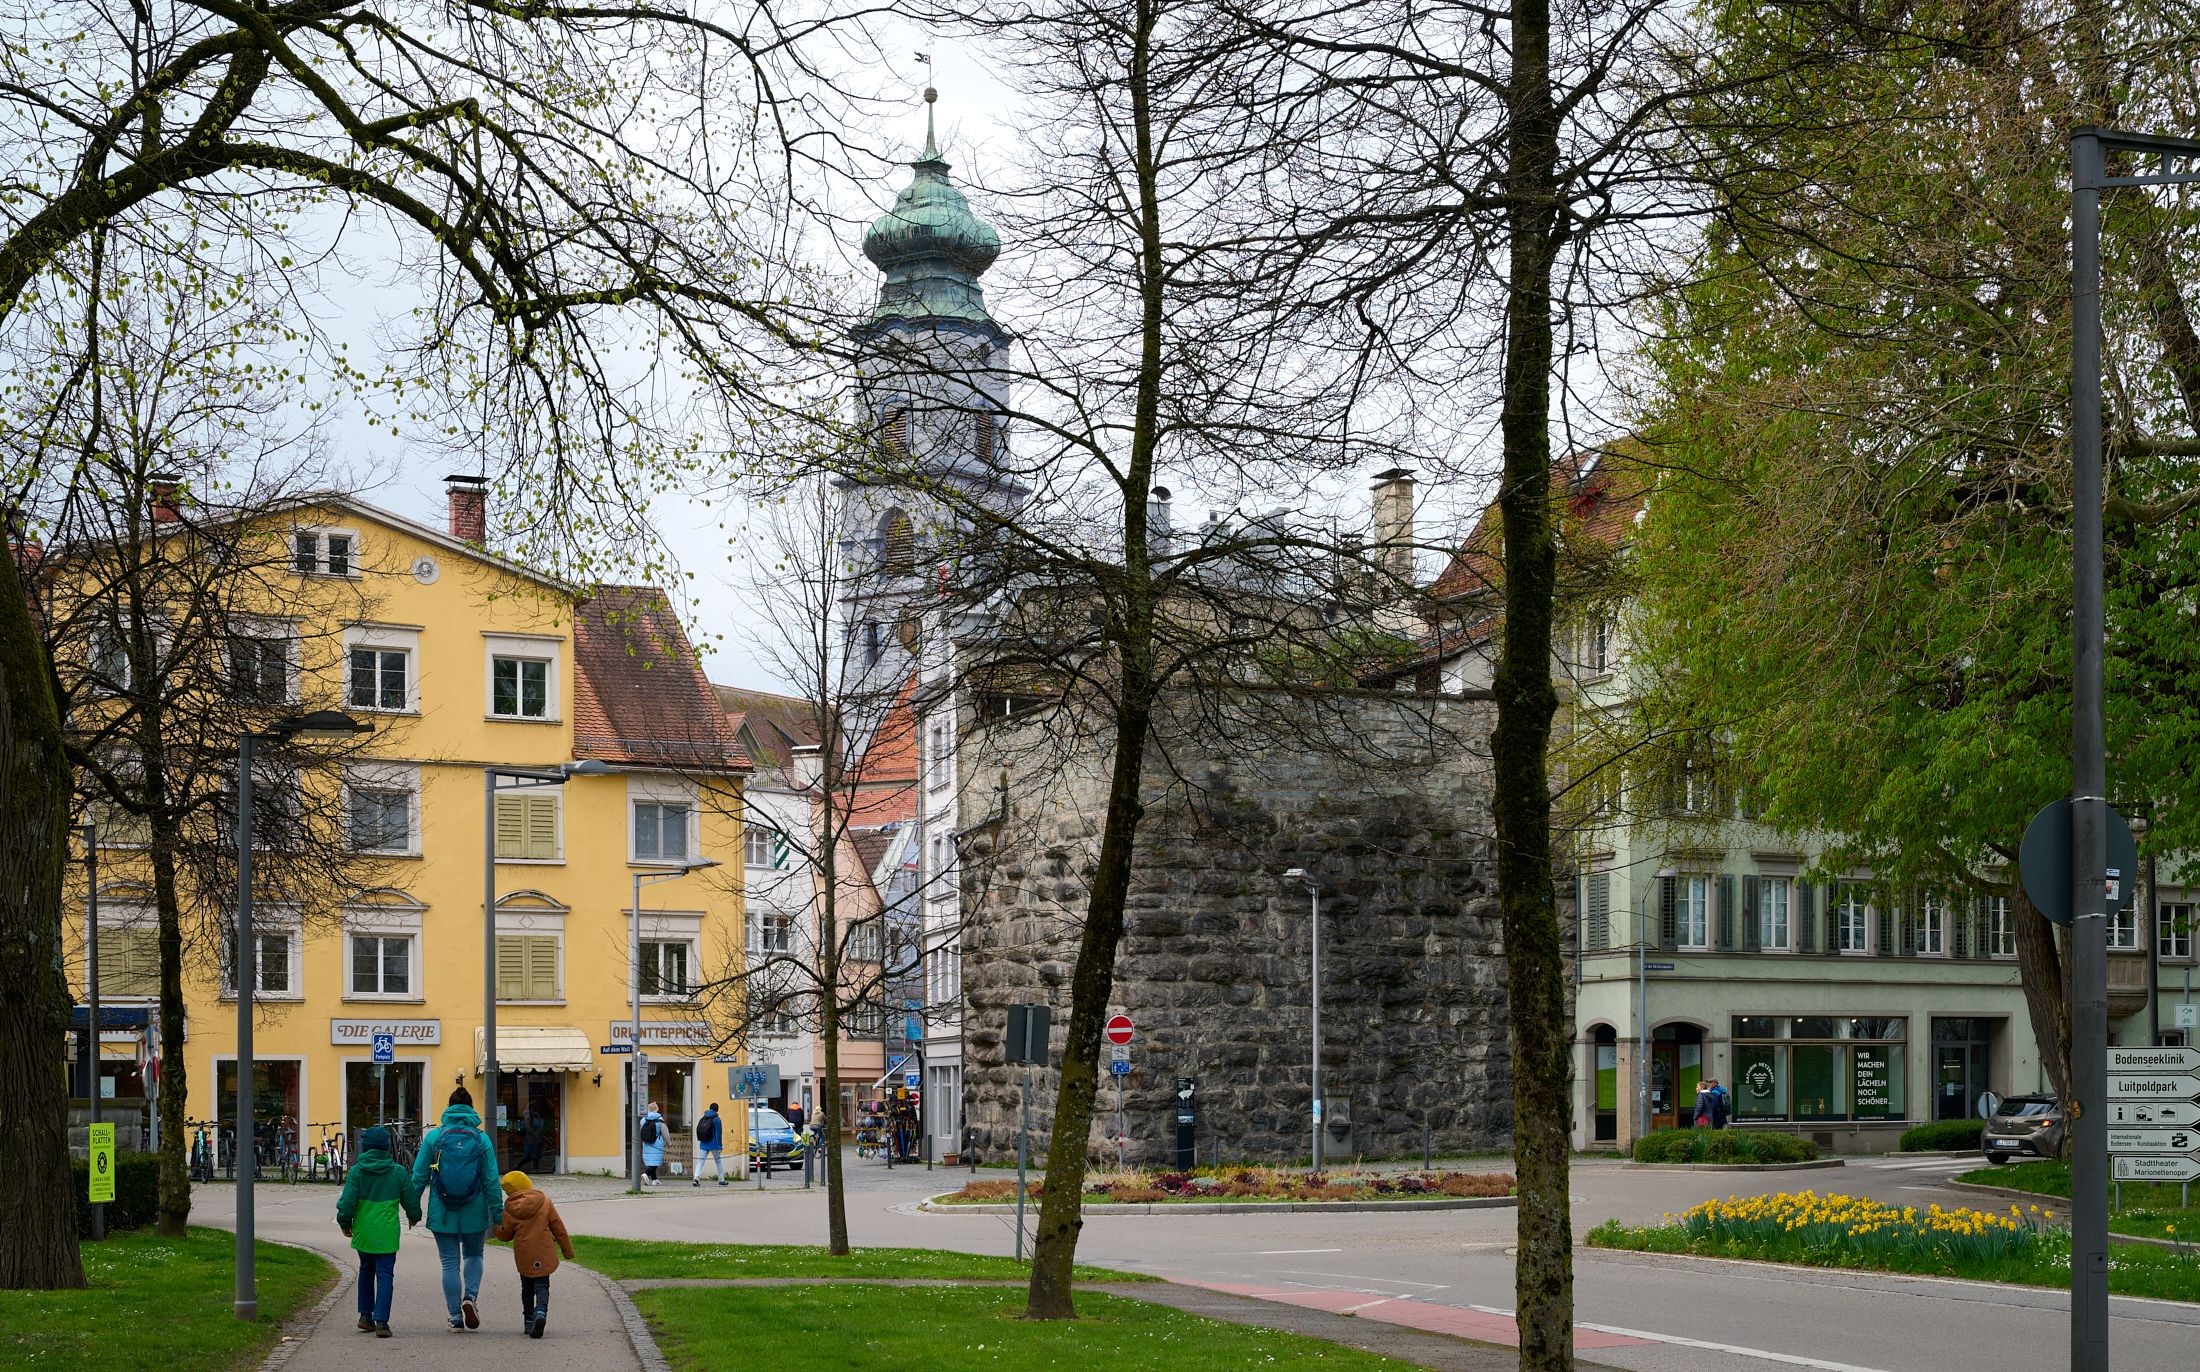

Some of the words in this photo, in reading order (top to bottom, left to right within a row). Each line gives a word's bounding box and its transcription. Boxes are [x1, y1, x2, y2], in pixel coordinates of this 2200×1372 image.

[337, 1025, 369, 1038] DIE
[612, 1026, 709, 1038] ORINTTEPPICHE
[1857, 1052, 1870, 1060] WIR
[2115, 1053, 2185, 1065] Bodenseeklinik
[1857, 1061, 1885, 1069] MACHEN
[1857, 1070, 1873, 1078] DEIN
[1857, 1078, 1887, 1087] LÄCHELN
[2119, 1081, 2178, 1094] Luitpoldpark
[92, 1136, 111, 1145] PLATTEN
[2135, 1169, 2189, 1177] Marionettenoper
